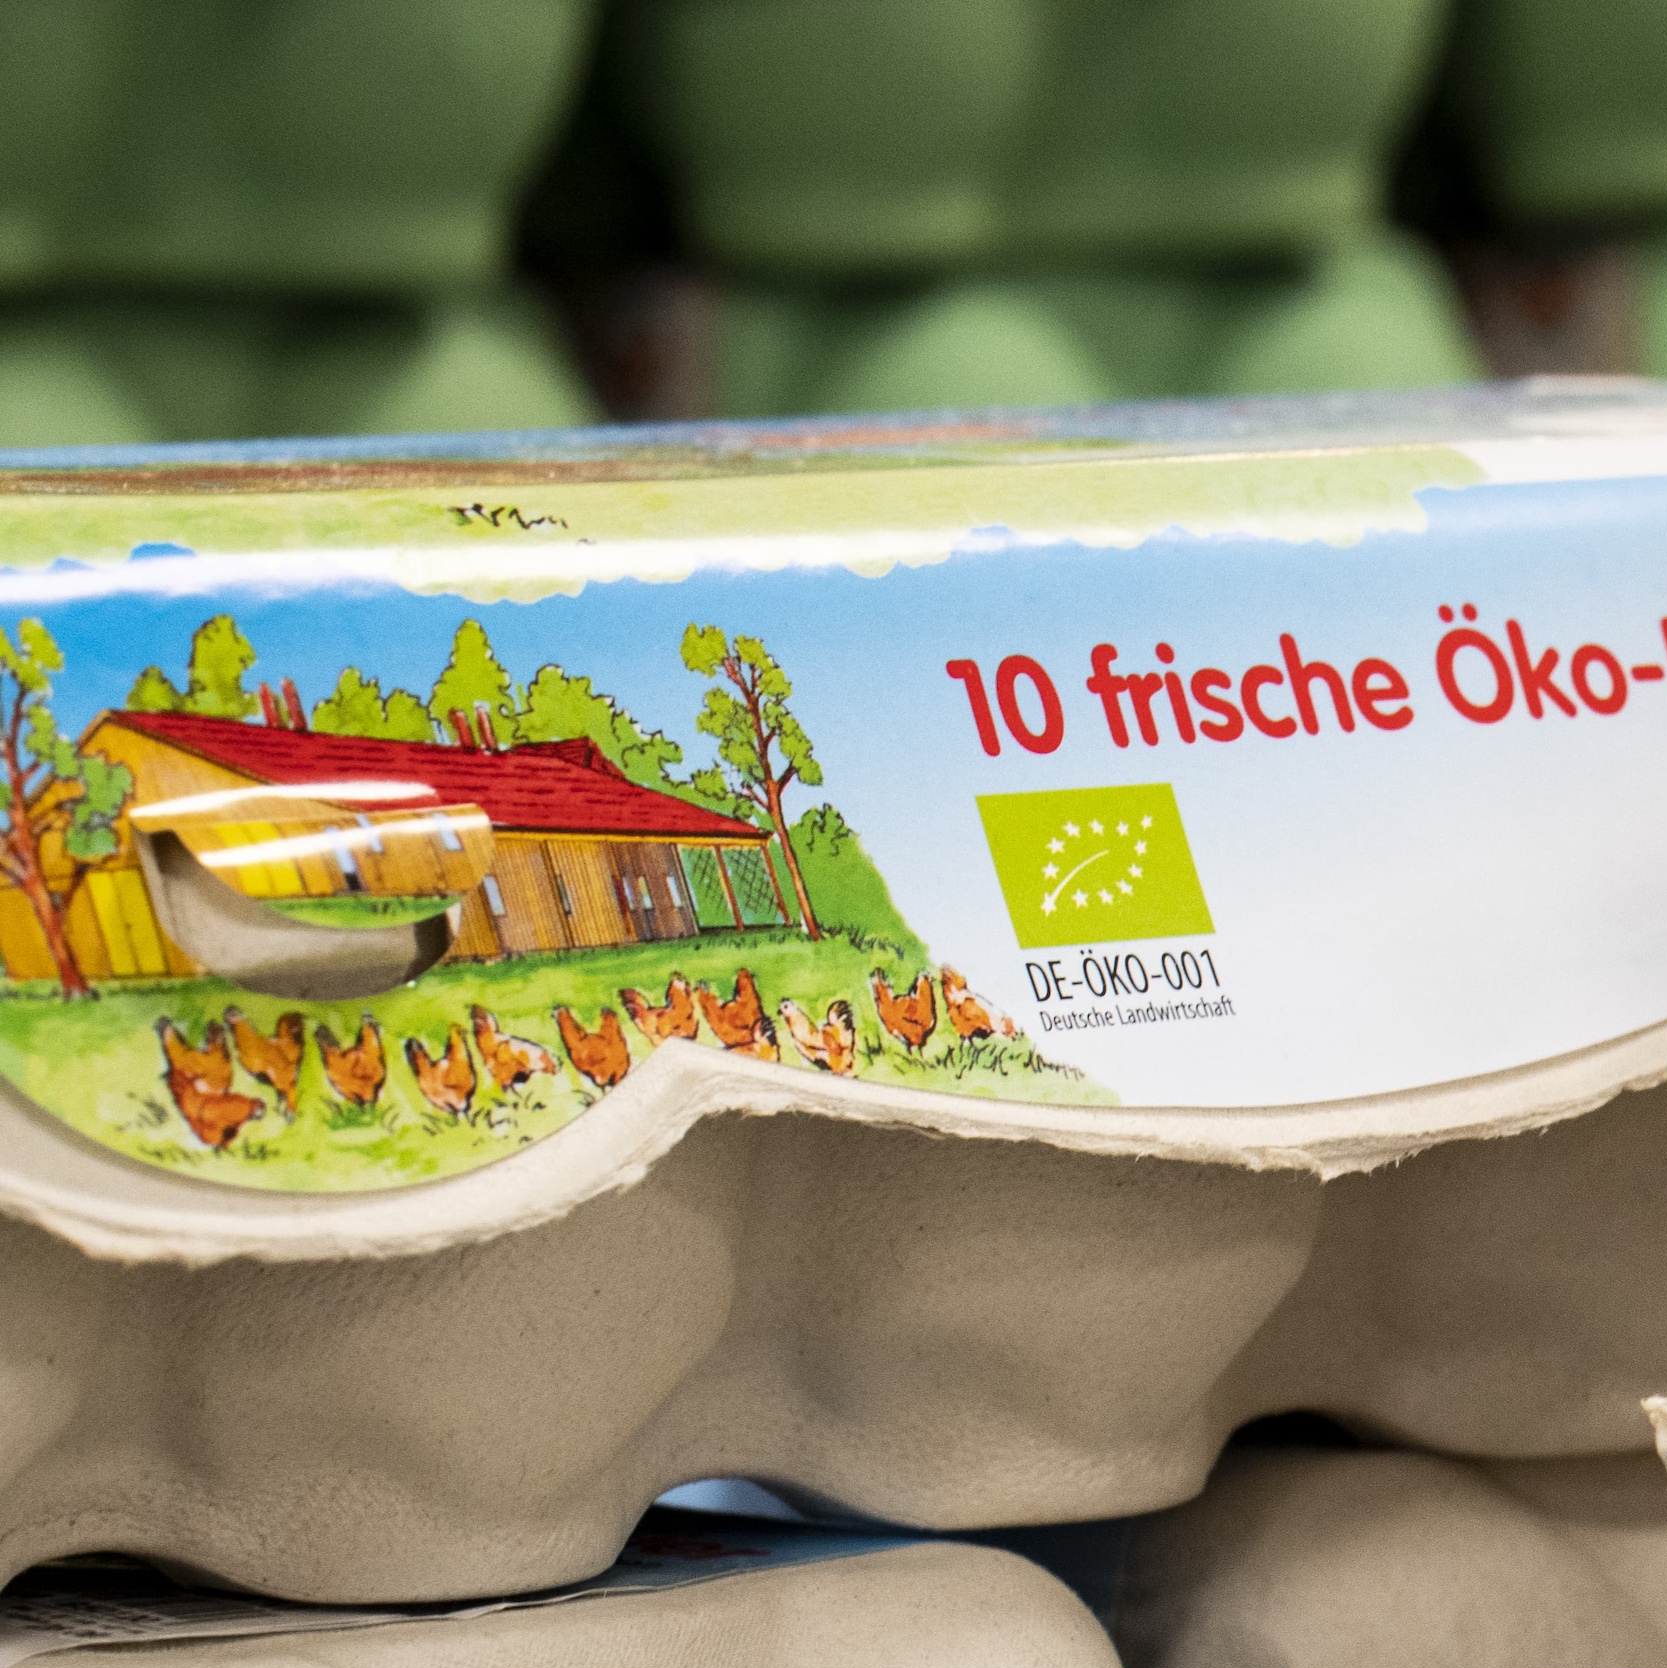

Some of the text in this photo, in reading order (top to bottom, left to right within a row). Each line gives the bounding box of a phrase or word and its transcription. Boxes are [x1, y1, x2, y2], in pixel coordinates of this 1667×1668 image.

[947, 653, 1065, 757] 10
[1086, 632, 1415, 748] frische
[1025, 949, 1221, 1002] DE-ÖKO-001
[1039, 995, 1236, 1032] Deutsche Landwirtschaft
